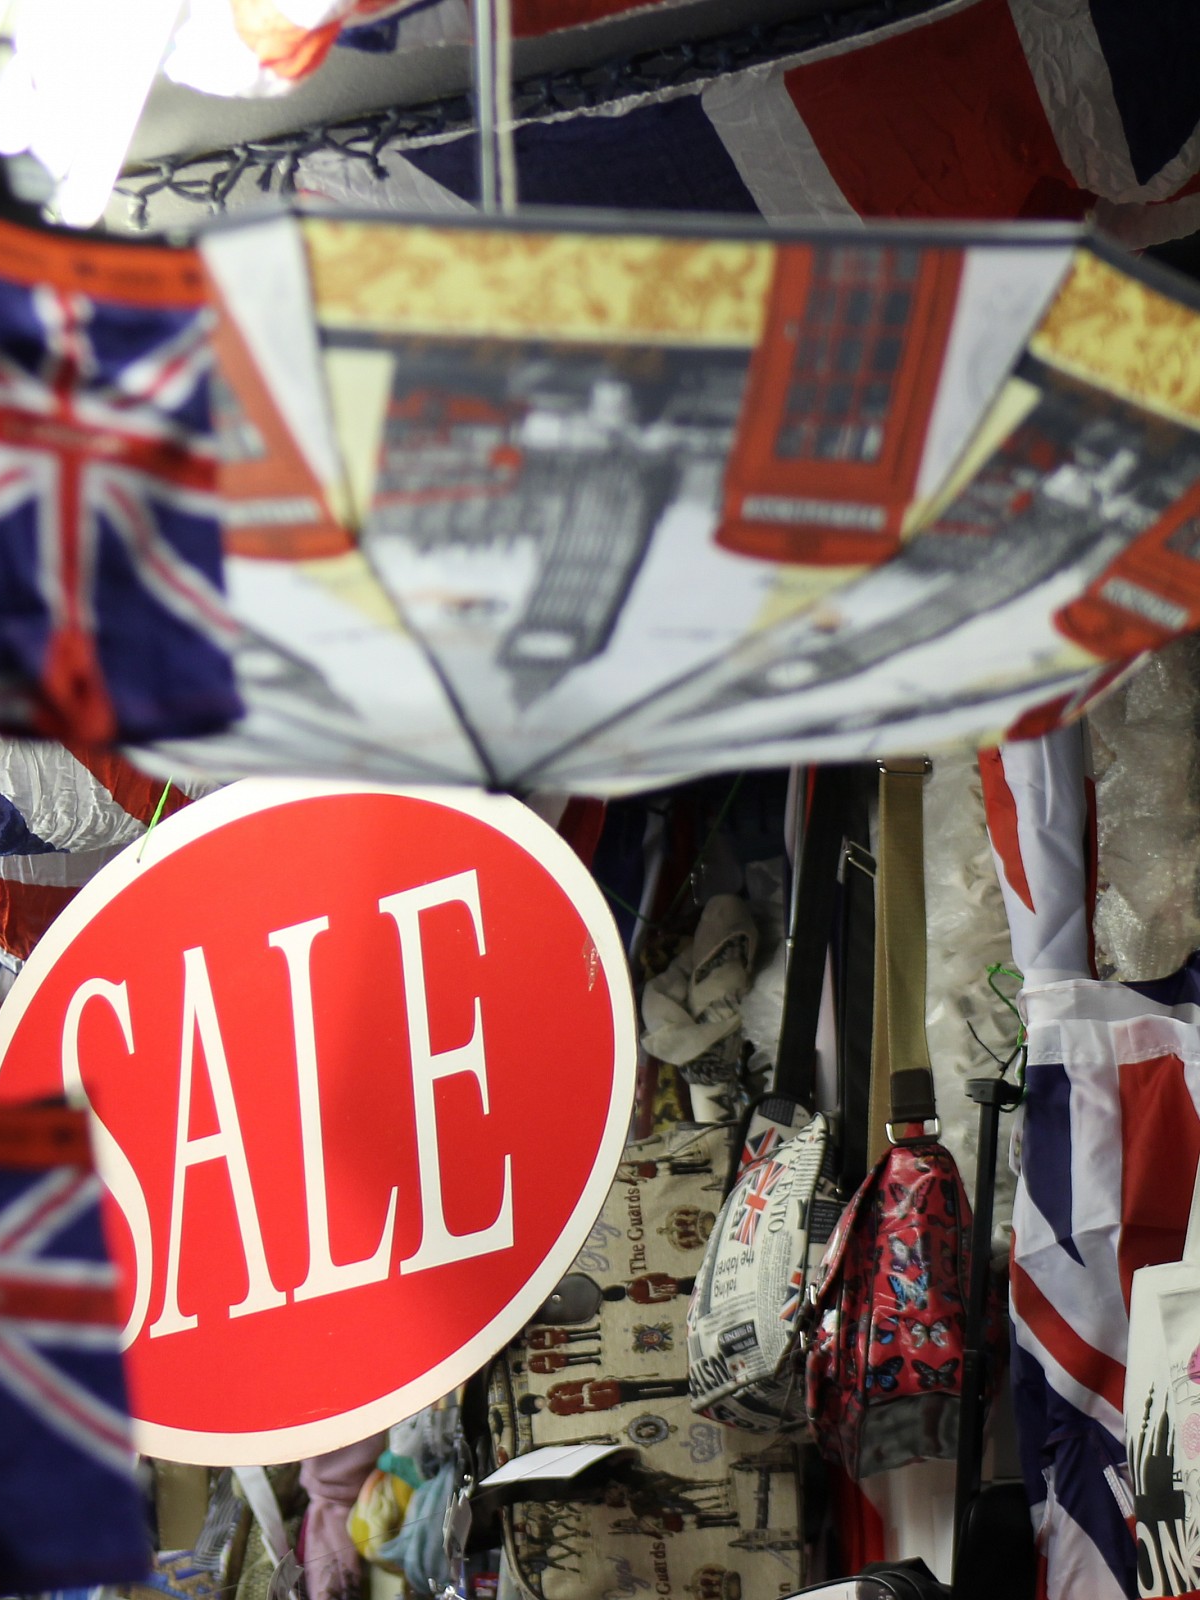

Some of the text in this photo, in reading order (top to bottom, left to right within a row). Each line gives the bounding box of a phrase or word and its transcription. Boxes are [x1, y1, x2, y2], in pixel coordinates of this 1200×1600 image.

[62, 869, 514, 1353] SALE
[624, 1188, 647, 1274] The Guards
[652, 1542, 671, 1595] Guards
